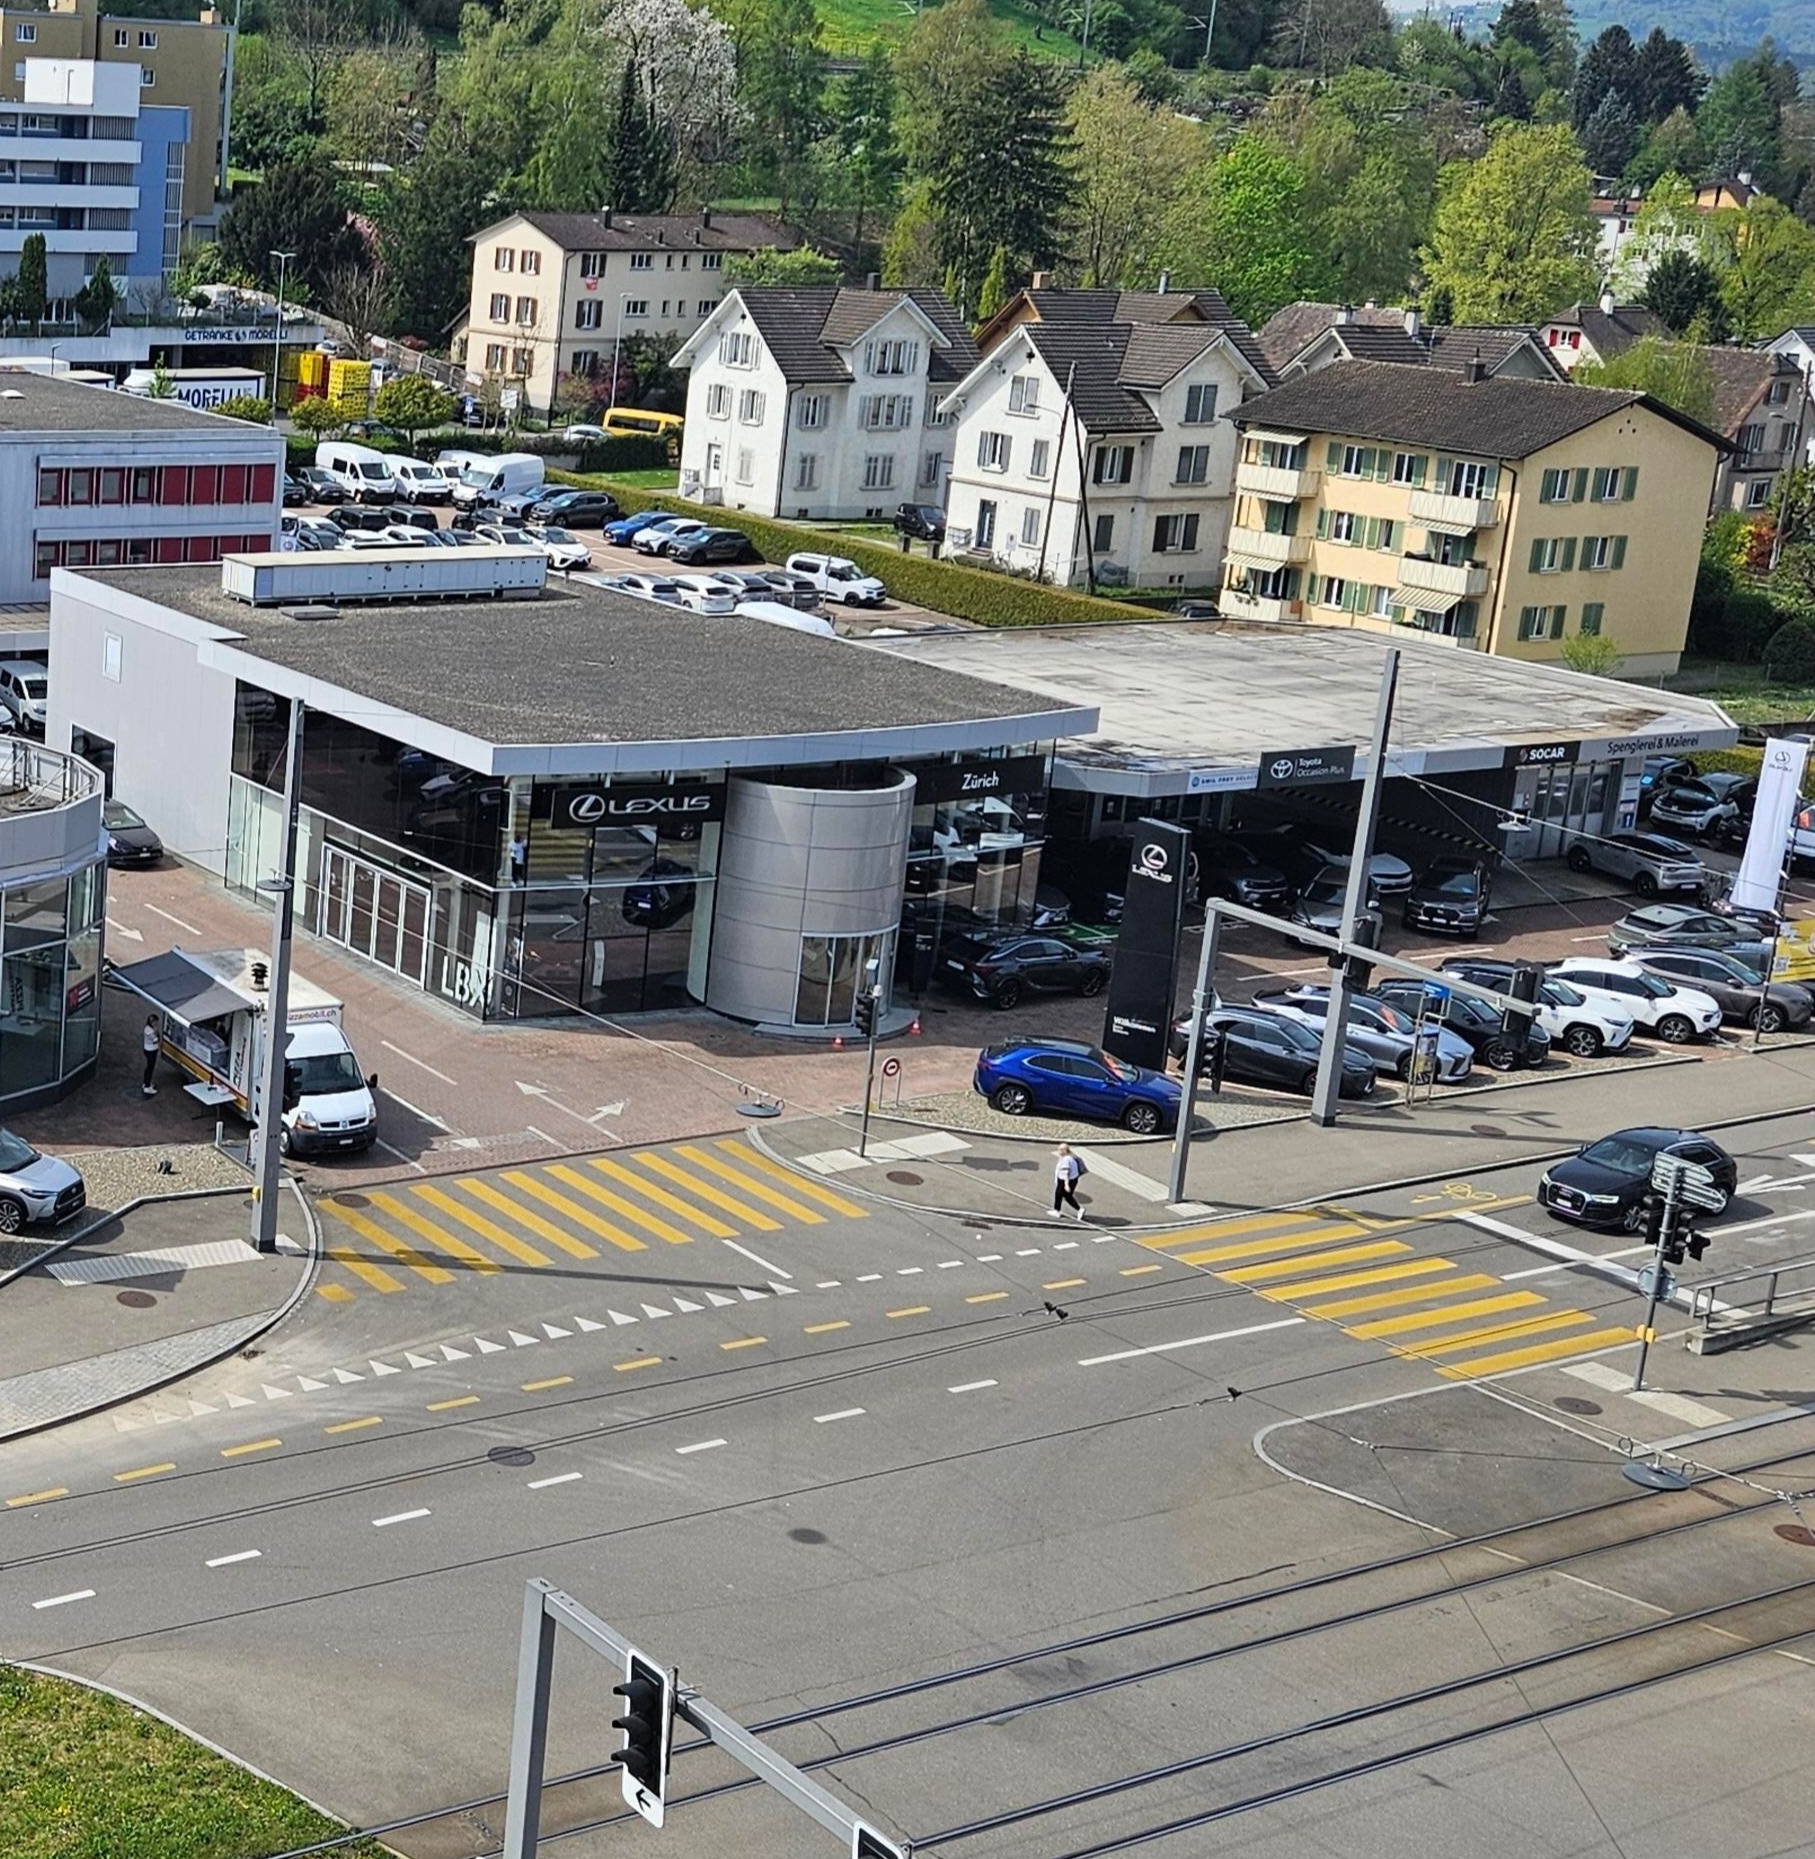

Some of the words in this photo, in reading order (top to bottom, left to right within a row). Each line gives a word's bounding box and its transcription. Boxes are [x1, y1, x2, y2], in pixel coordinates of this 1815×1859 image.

[249, 330, 288, 340] MORELLI
[1608, 737, 1656, 755] Spenglerei
[1665, 735, 1699, 747] Malerei
[1529, 747, 1564, 760] SOCAR
[1299, 758, 1322, 767] Toyota
[1297, 768, 1328, 777] Occasion
[1330, 767, 1345, 775] Plus
[962, 772, 1000, 791] Zürich
[608, 795, 710, 815] LEXUS
